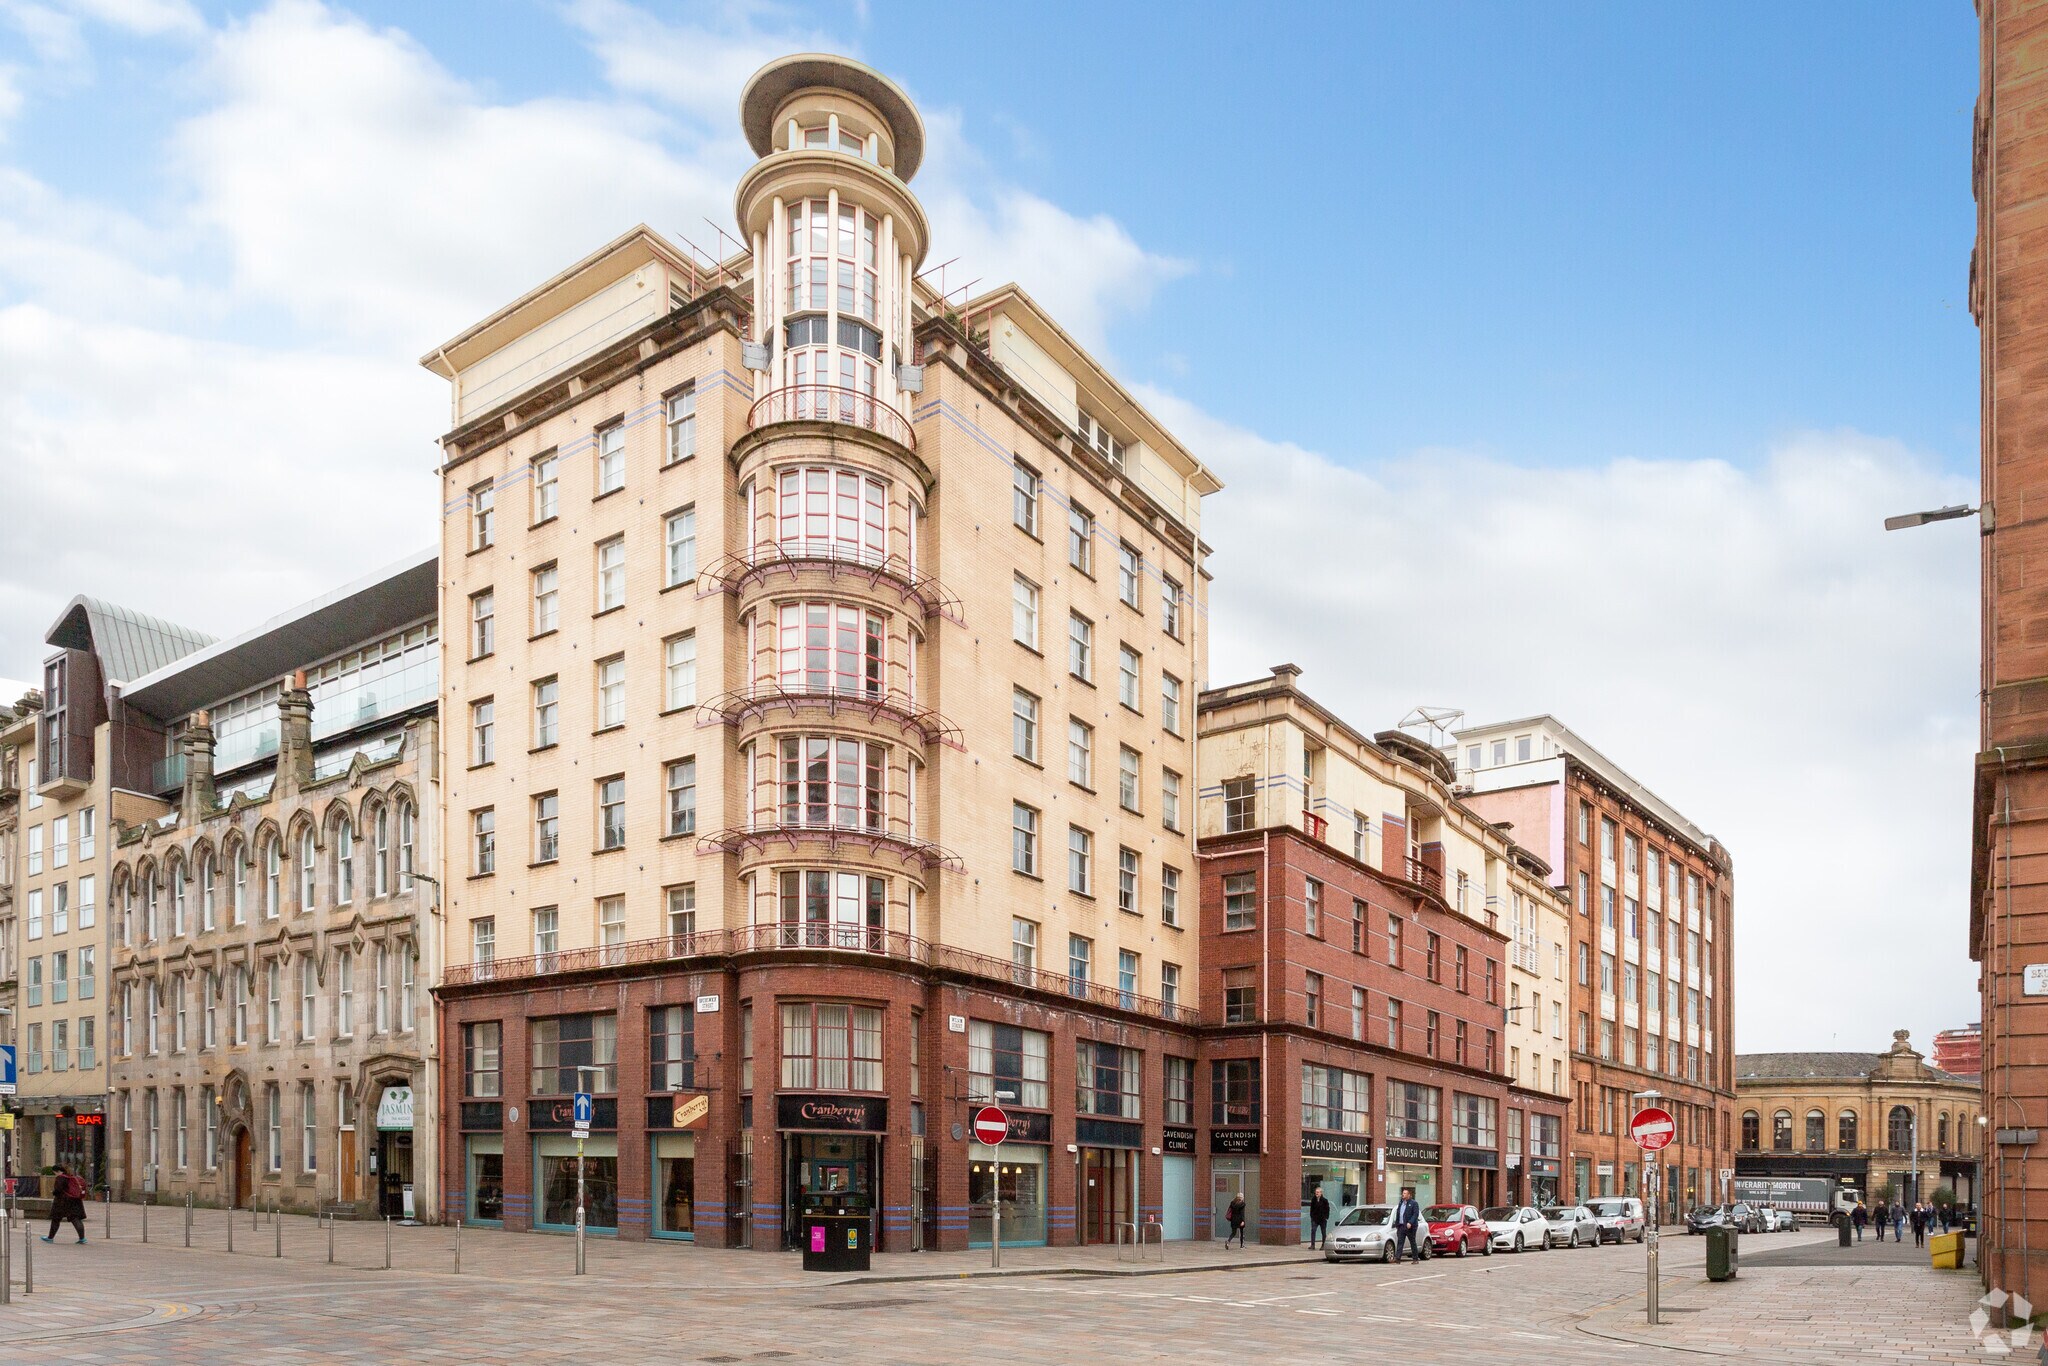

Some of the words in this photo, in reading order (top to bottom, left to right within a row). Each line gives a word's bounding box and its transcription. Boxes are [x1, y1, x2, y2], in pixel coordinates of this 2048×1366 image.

[801, 1102, 865, 1120] Cranberry's
[76, 1115, 102, 1125] BAR
[1163, 1130, 1194, 1140] CAVENDISH
[1215, 1131, 1257, 1139] CAVENDISH
[1168, 1141, 1188, 1150] CLINIC
[1300, 1138, 1343, 1152] CAVENDISH
[1345, 1142, 1369, 1154] CLINIC
[1385, 1146, 1418, 1158] CAVENDISH
[1419, 1149, 1439, 1160] CLINIC
[1772, 1181, 1801, 1190] MORTON
